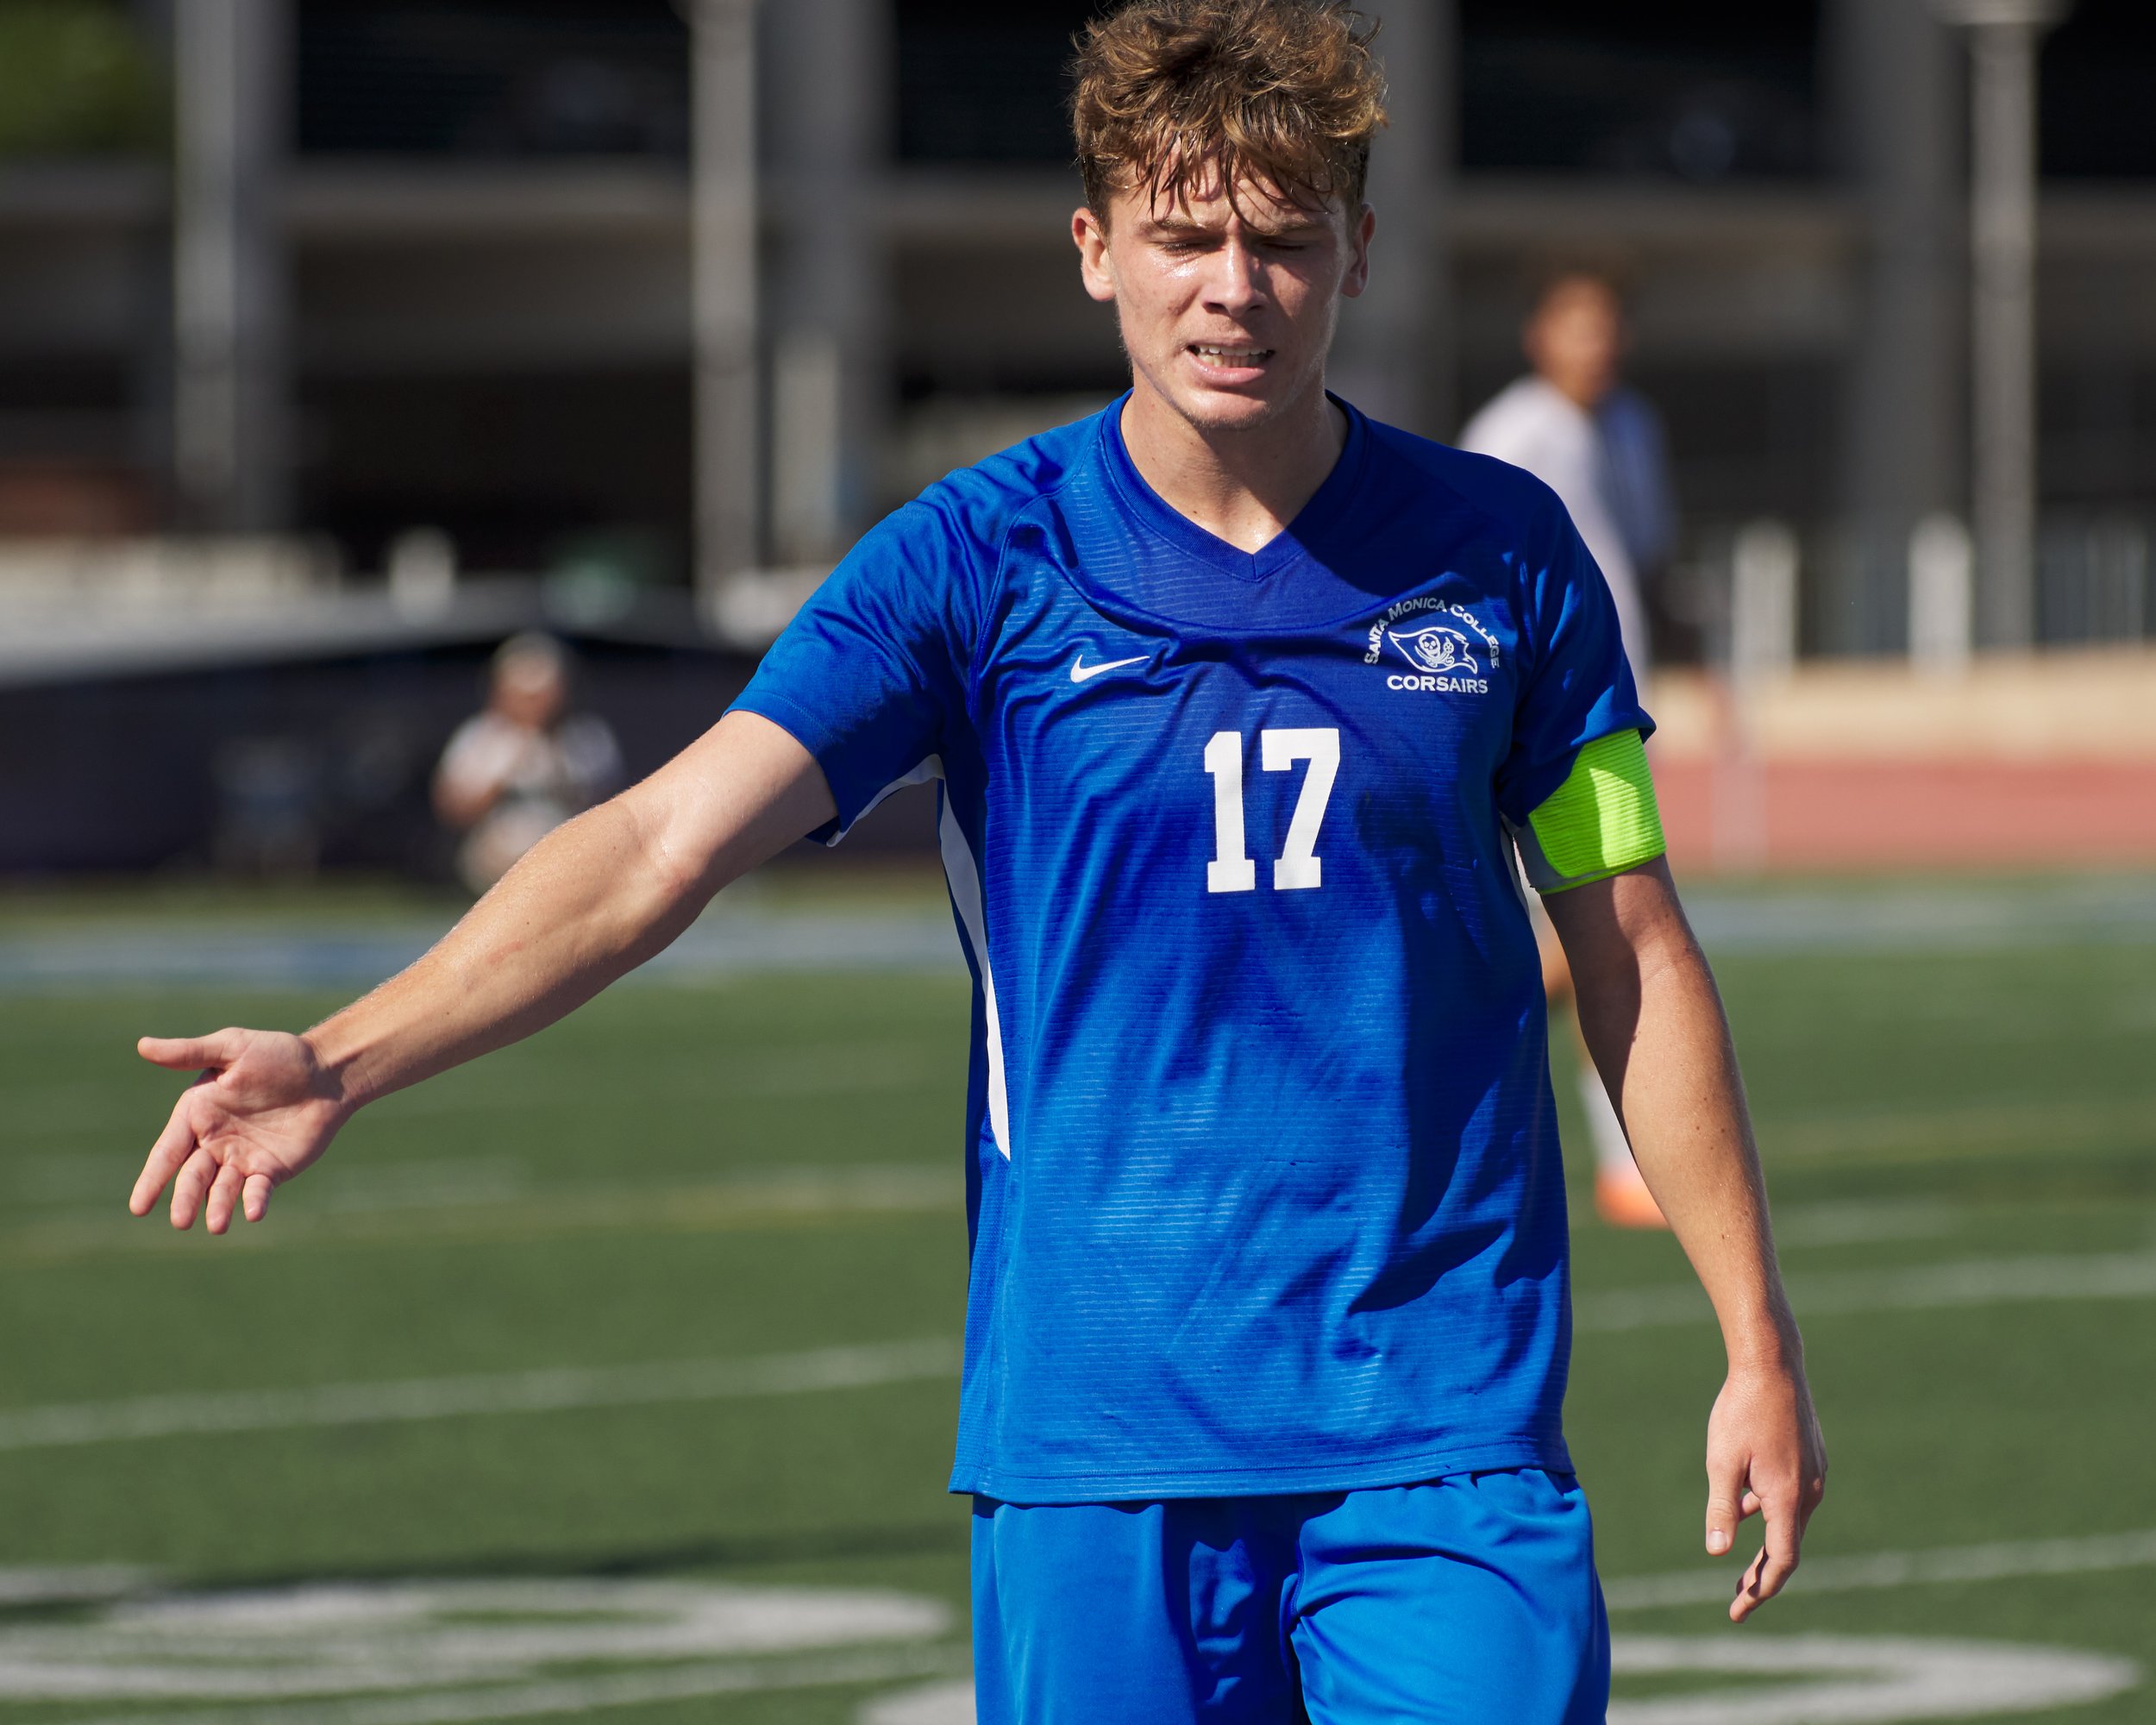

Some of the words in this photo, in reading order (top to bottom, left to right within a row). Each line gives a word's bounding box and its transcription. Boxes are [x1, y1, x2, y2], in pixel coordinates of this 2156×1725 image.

[1363, 618, 1389, 664] SANTA
[1388, 597, 1447, 620] MONICA
[1450, 604, 1500, 668] COLLEGE
[1387, 674, 1489, 694] CORSAIRS
[1204, 728, 1340, 893] 17
